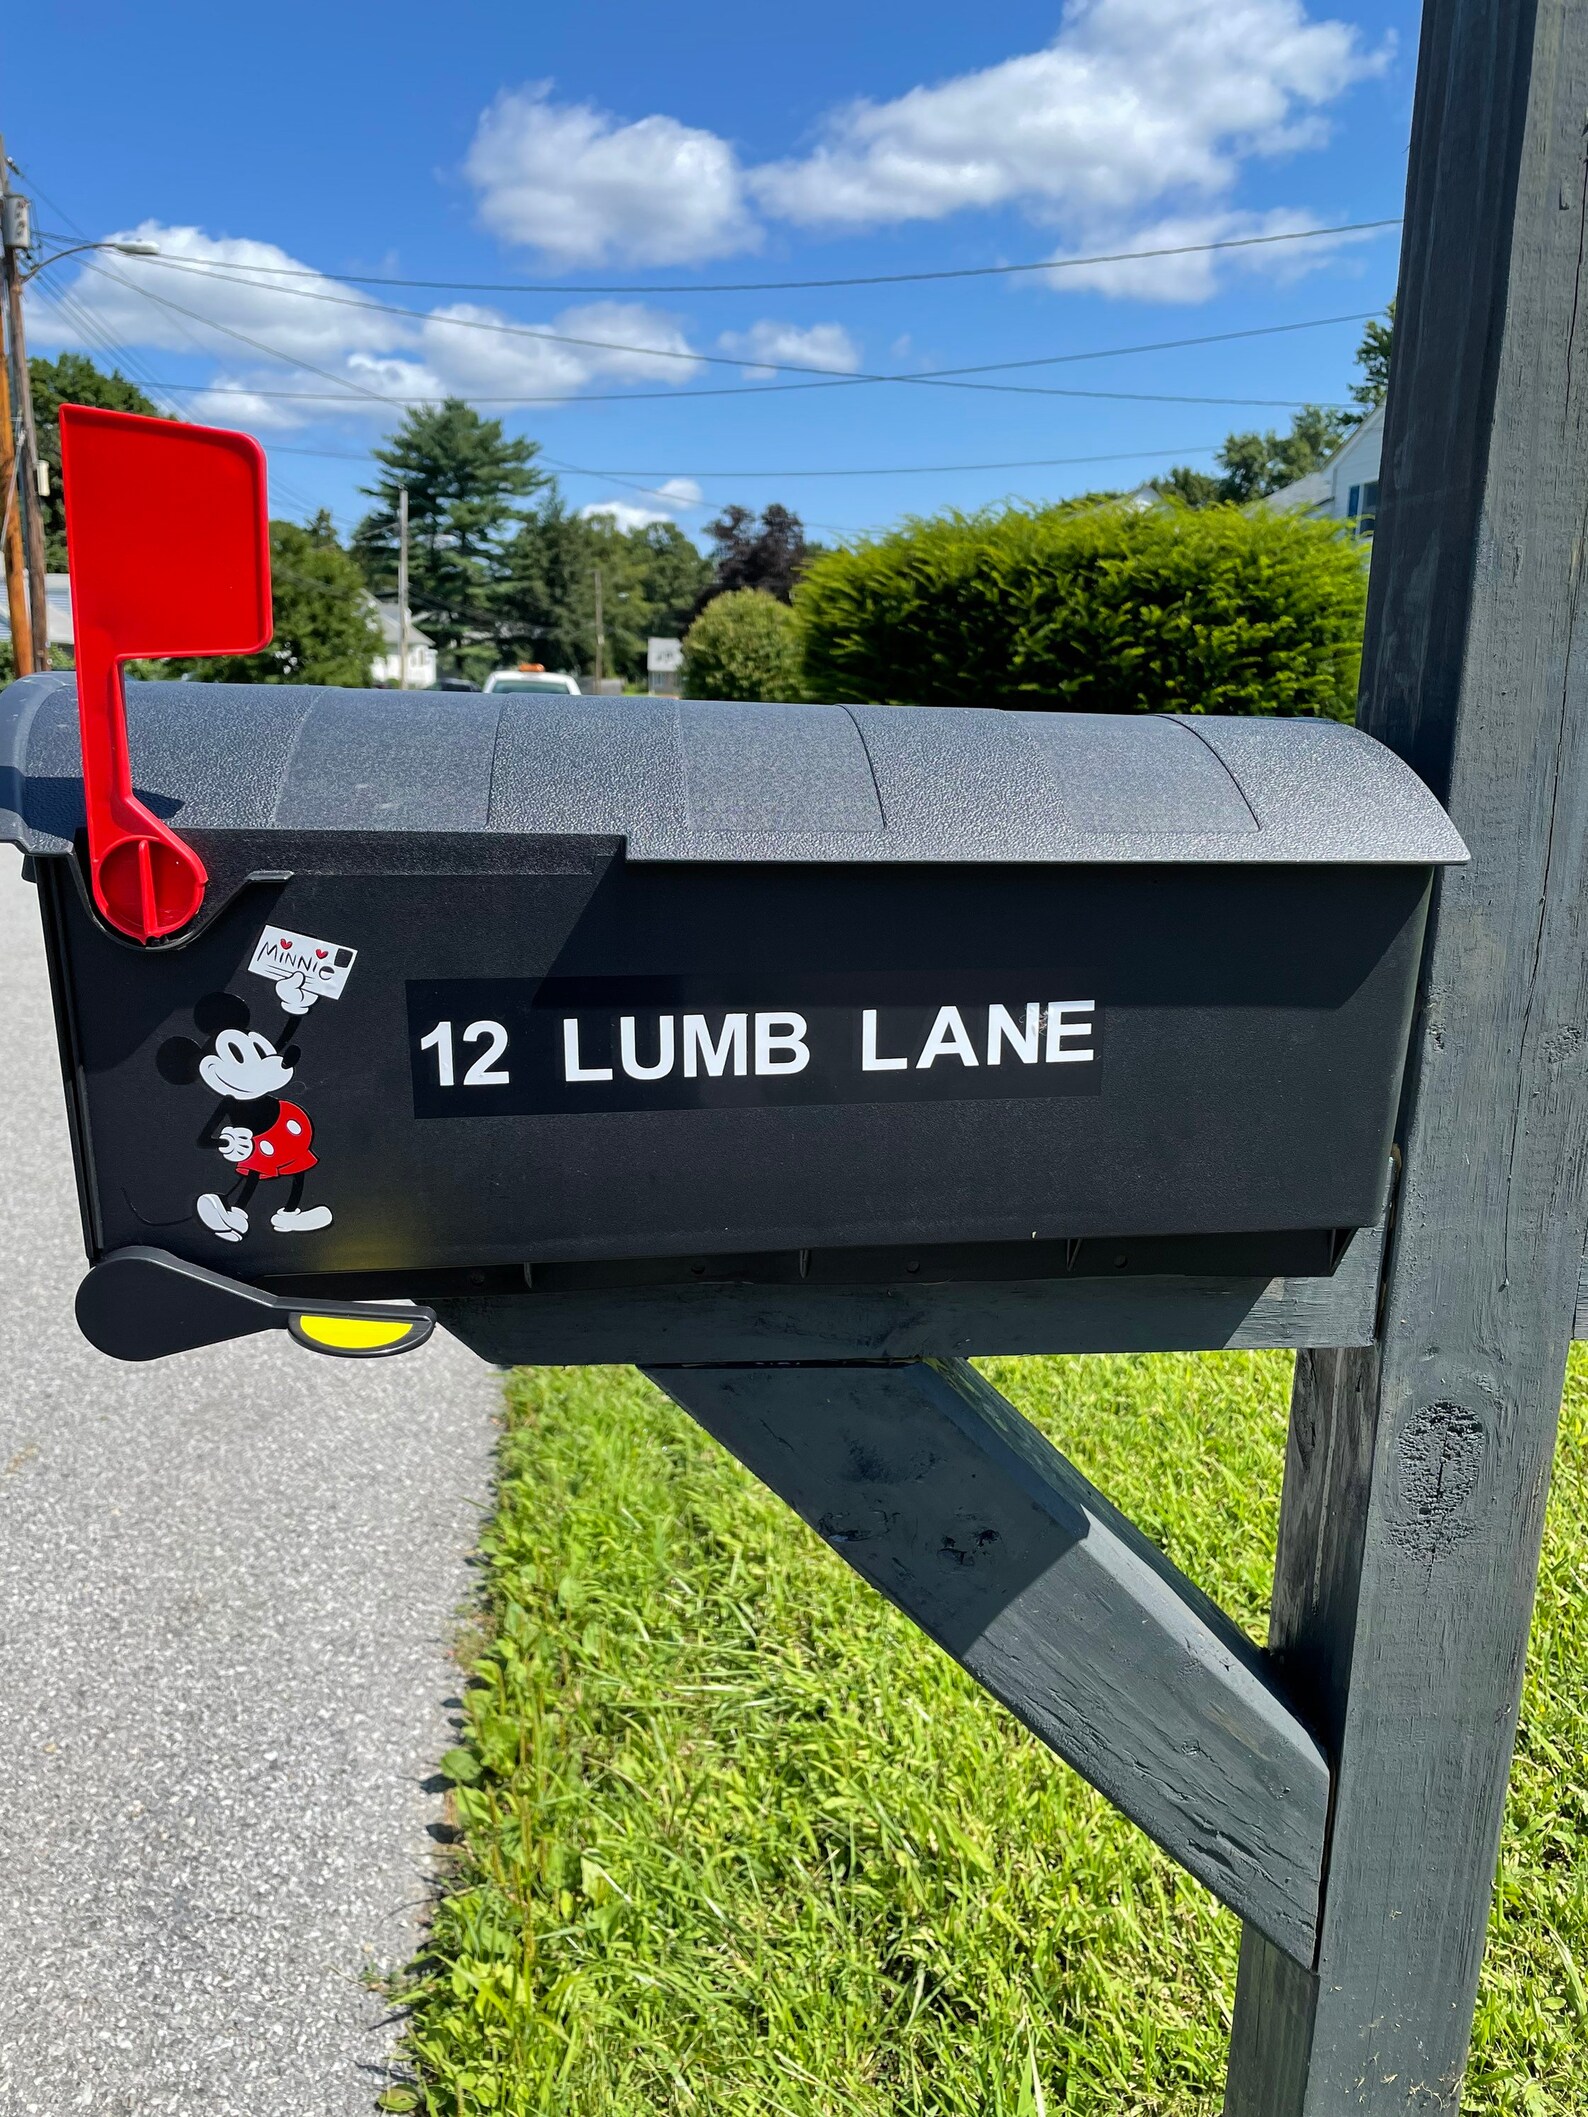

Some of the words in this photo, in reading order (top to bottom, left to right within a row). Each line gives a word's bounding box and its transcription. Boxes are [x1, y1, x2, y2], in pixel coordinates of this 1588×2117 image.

[420, 1021, 510, 1086] 12
[563, 1011, 810, 1082] LUMB
[860, 999, 1095, 1072] LANE
